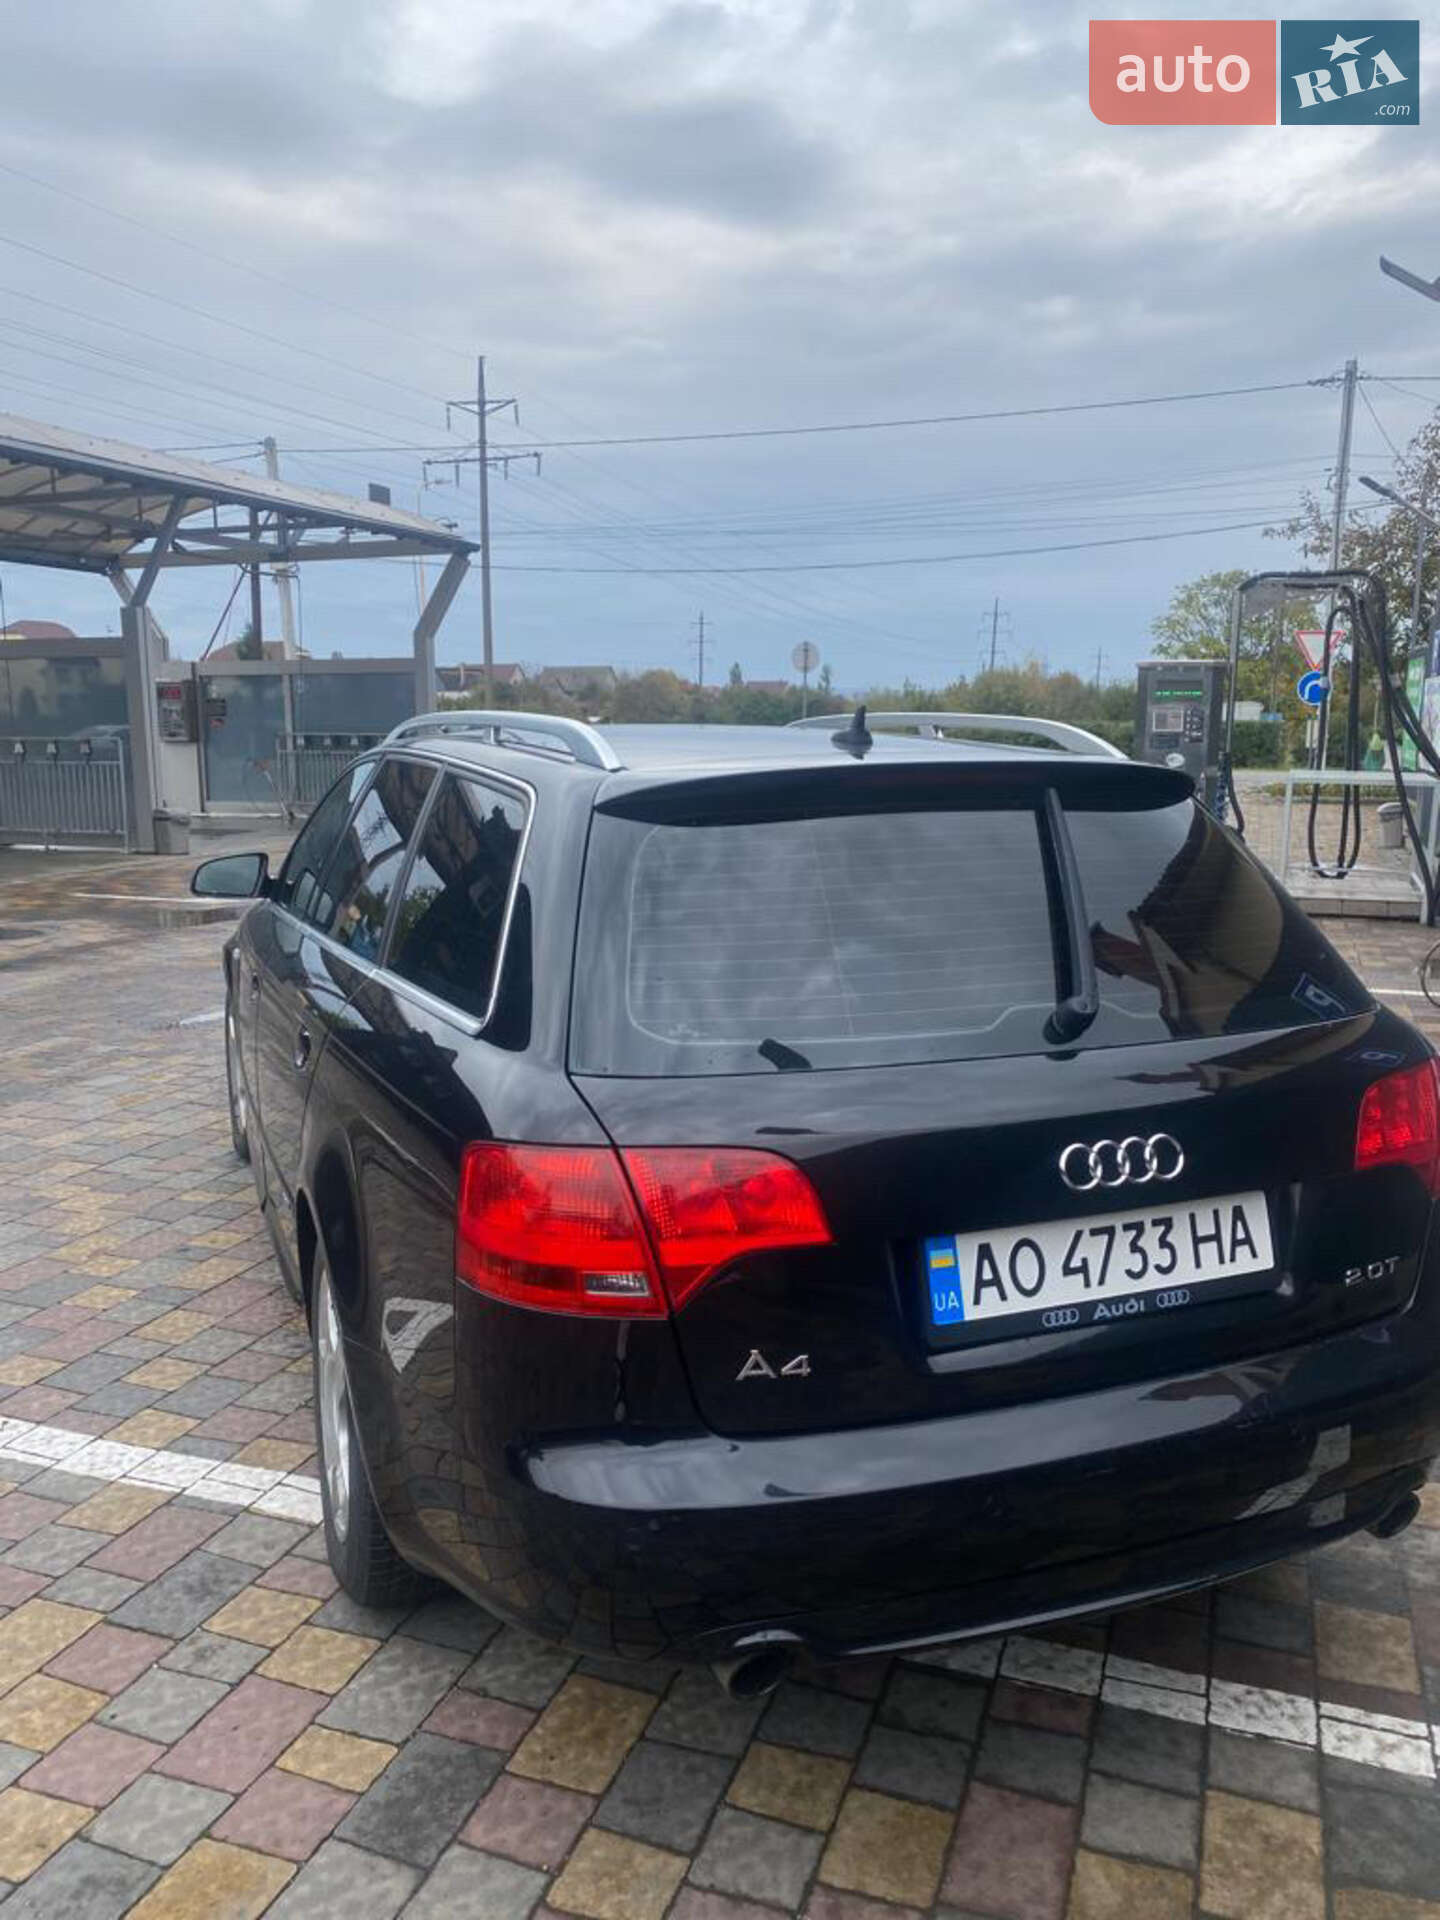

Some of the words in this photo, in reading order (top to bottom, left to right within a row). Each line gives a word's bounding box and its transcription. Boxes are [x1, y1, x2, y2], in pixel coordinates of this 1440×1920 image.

[973, 1237, 1046, 1306] AO
[1062, 1216, 1178, 1288] 4733
[1188, 1204, 1259, 1269] HA
[933, 1290, 961, 1312] UA
[1093, 1298, 1145, 1321] Audi
[735, 1349, 812, 1381] A4
